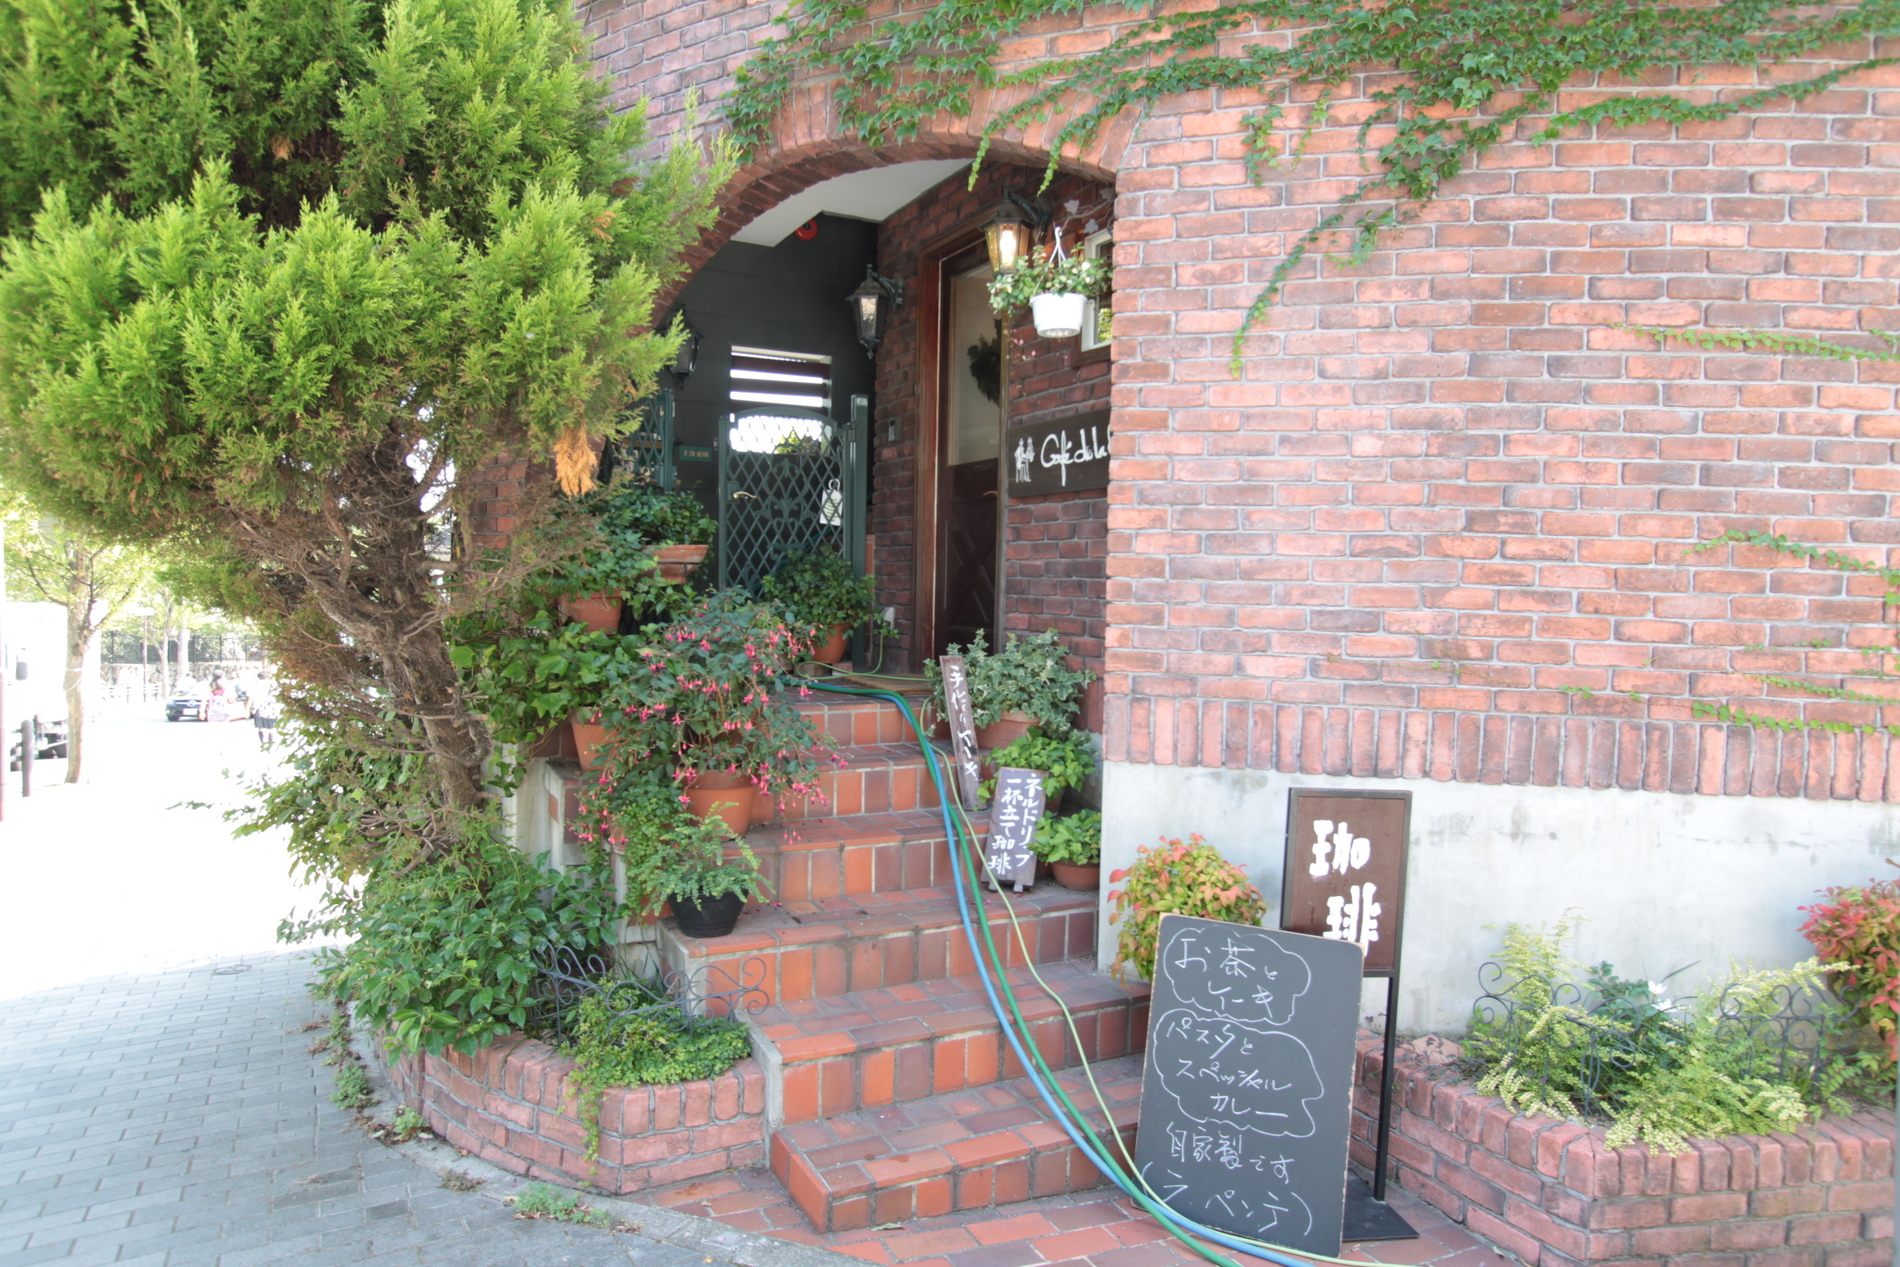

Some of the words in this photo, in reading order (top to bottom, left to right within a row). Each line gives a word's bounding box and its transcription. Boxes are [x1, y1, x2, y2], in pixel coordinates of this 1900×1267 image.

[949, 665, 979, 780] 手作りケーキ
[988, 778, 1024, 875] 一杯立て珈琲
[1309, 820, 1382, 957] 珈琲
[1175, 938, 1278, 980] お茶と
[1208, 981, 1273, 1019] ケーキ
[1166, 1017, 1254, 1060] パスタと
[1210, 1093, 1289, 1118] カレー
[1166, 1121, 1295, 1185] 自家製です
